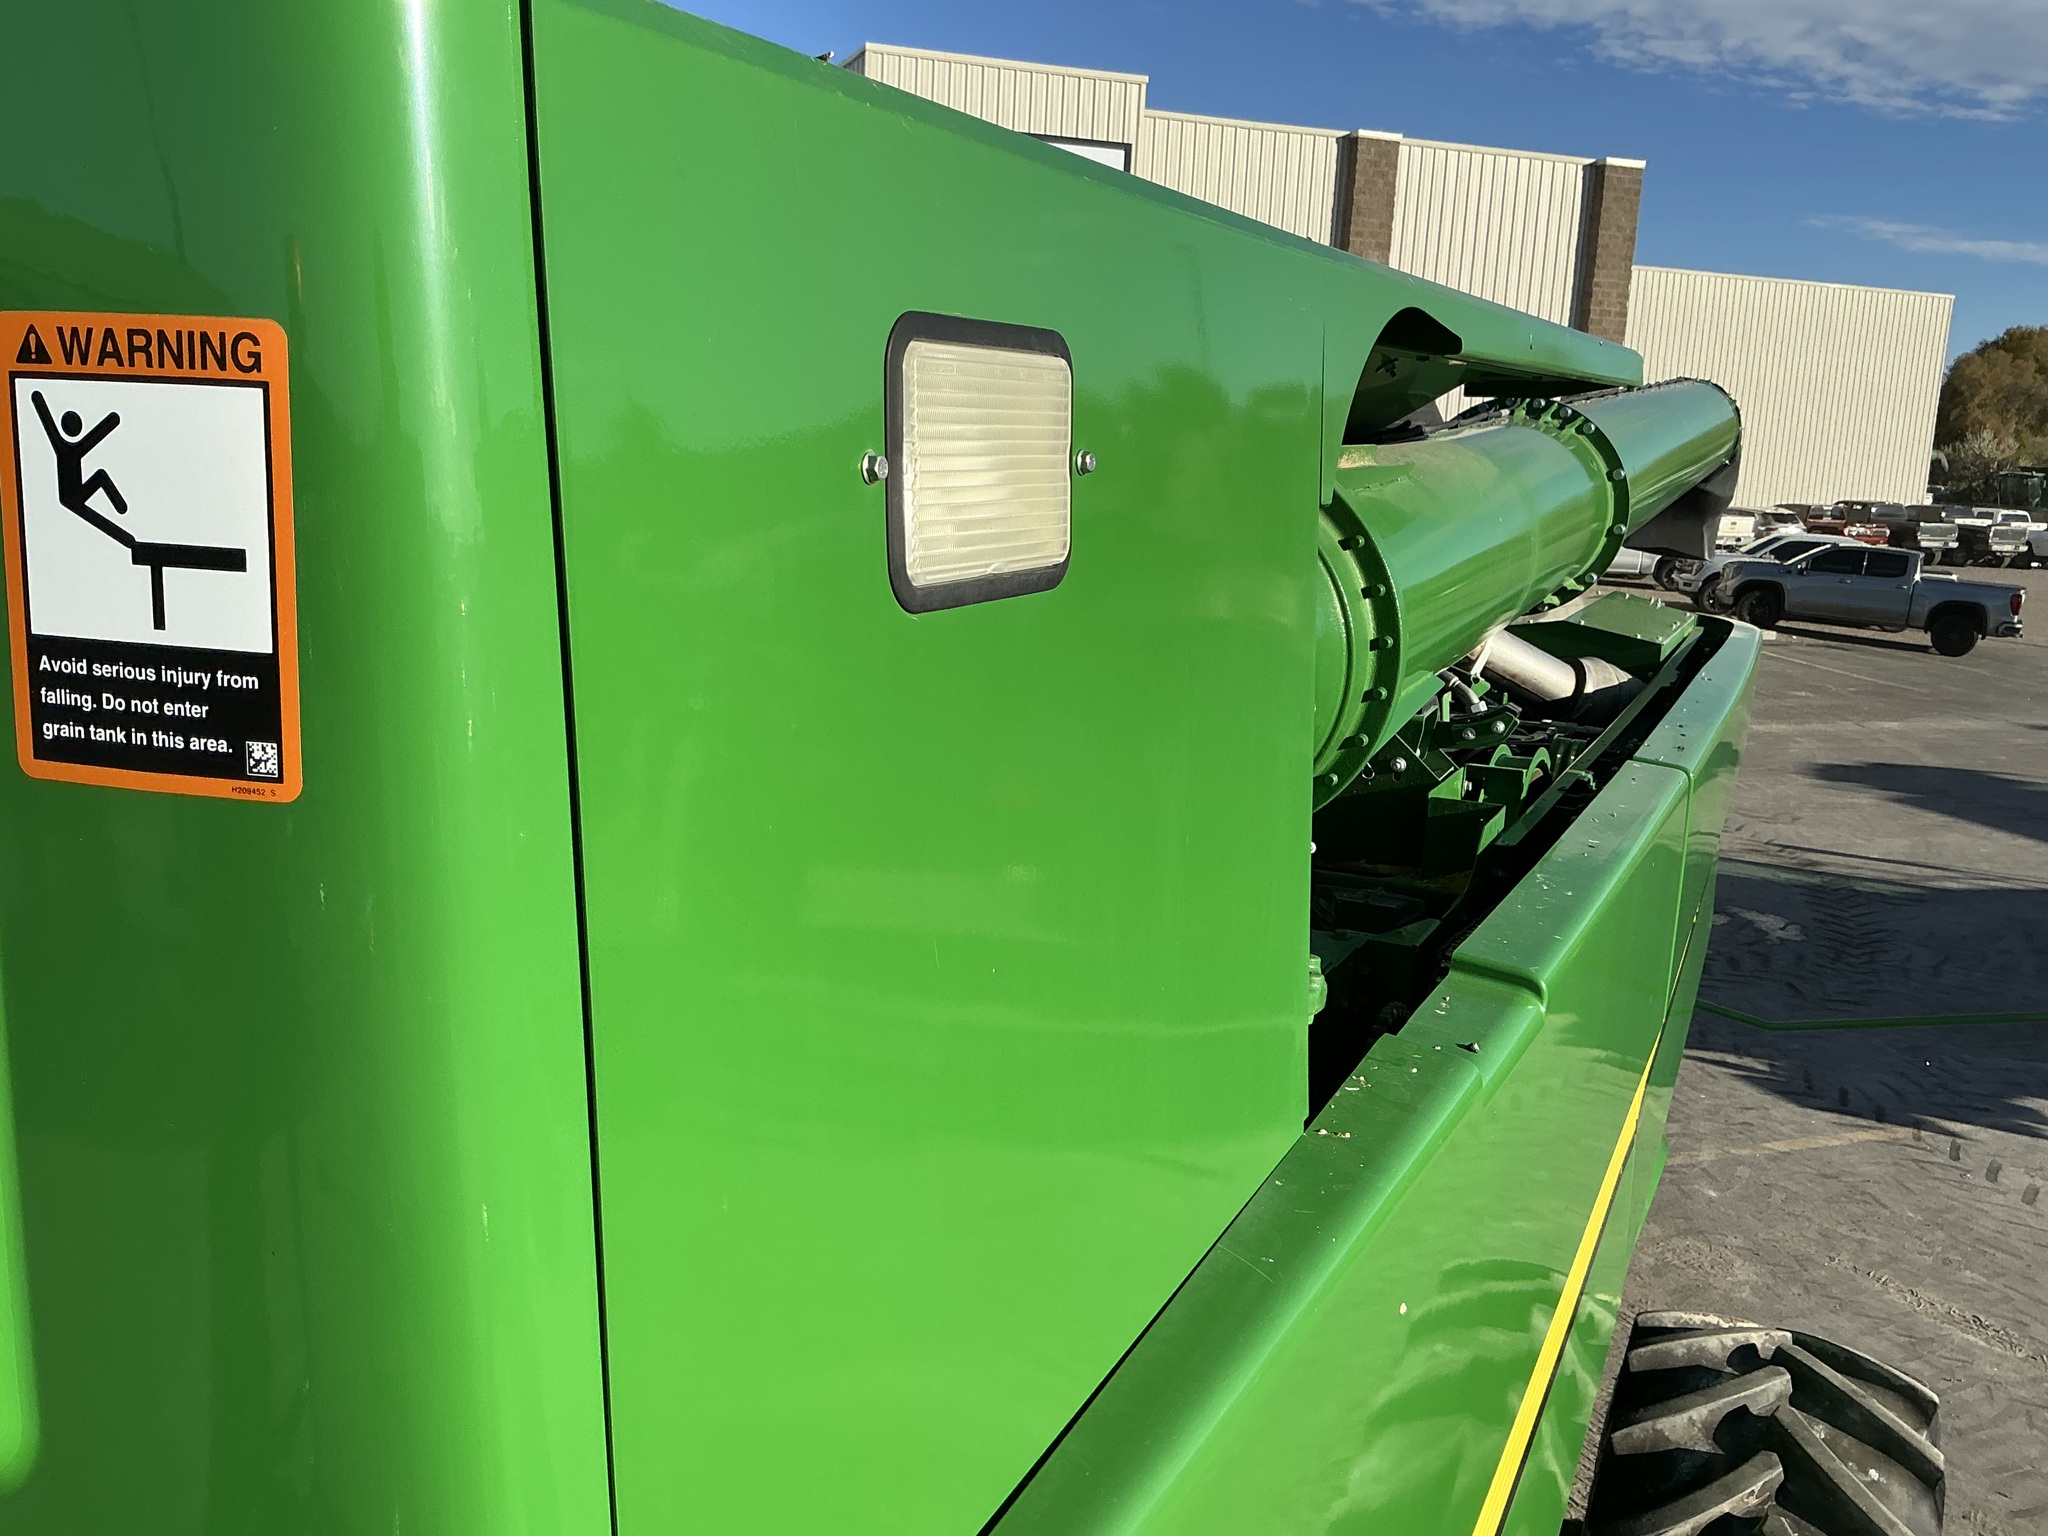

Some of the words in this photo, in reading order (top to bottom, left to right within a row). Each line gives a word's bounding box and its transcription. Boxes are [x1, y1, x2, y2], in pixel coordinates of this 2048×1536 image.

[57, 326, 262, 374] WARNING
[39, 655, 87, 675] Avoid
[92, 662, 156, 682] serious
[161, 666, 211, 690] injury
[216, 671, 259, 690] from
[40, 687, 97, 712] falling.
[102, 694, 126, 712] Do
[131, 699, 159, 715] not
[163, 703, 209, 719] enter
[42, 721, 85, 740] grain
[89, 724, 127, 744] tank
[131, 728, 148, 746] in
[151, 731, 185, 750] this
[189, 739, 233, 754] area.
